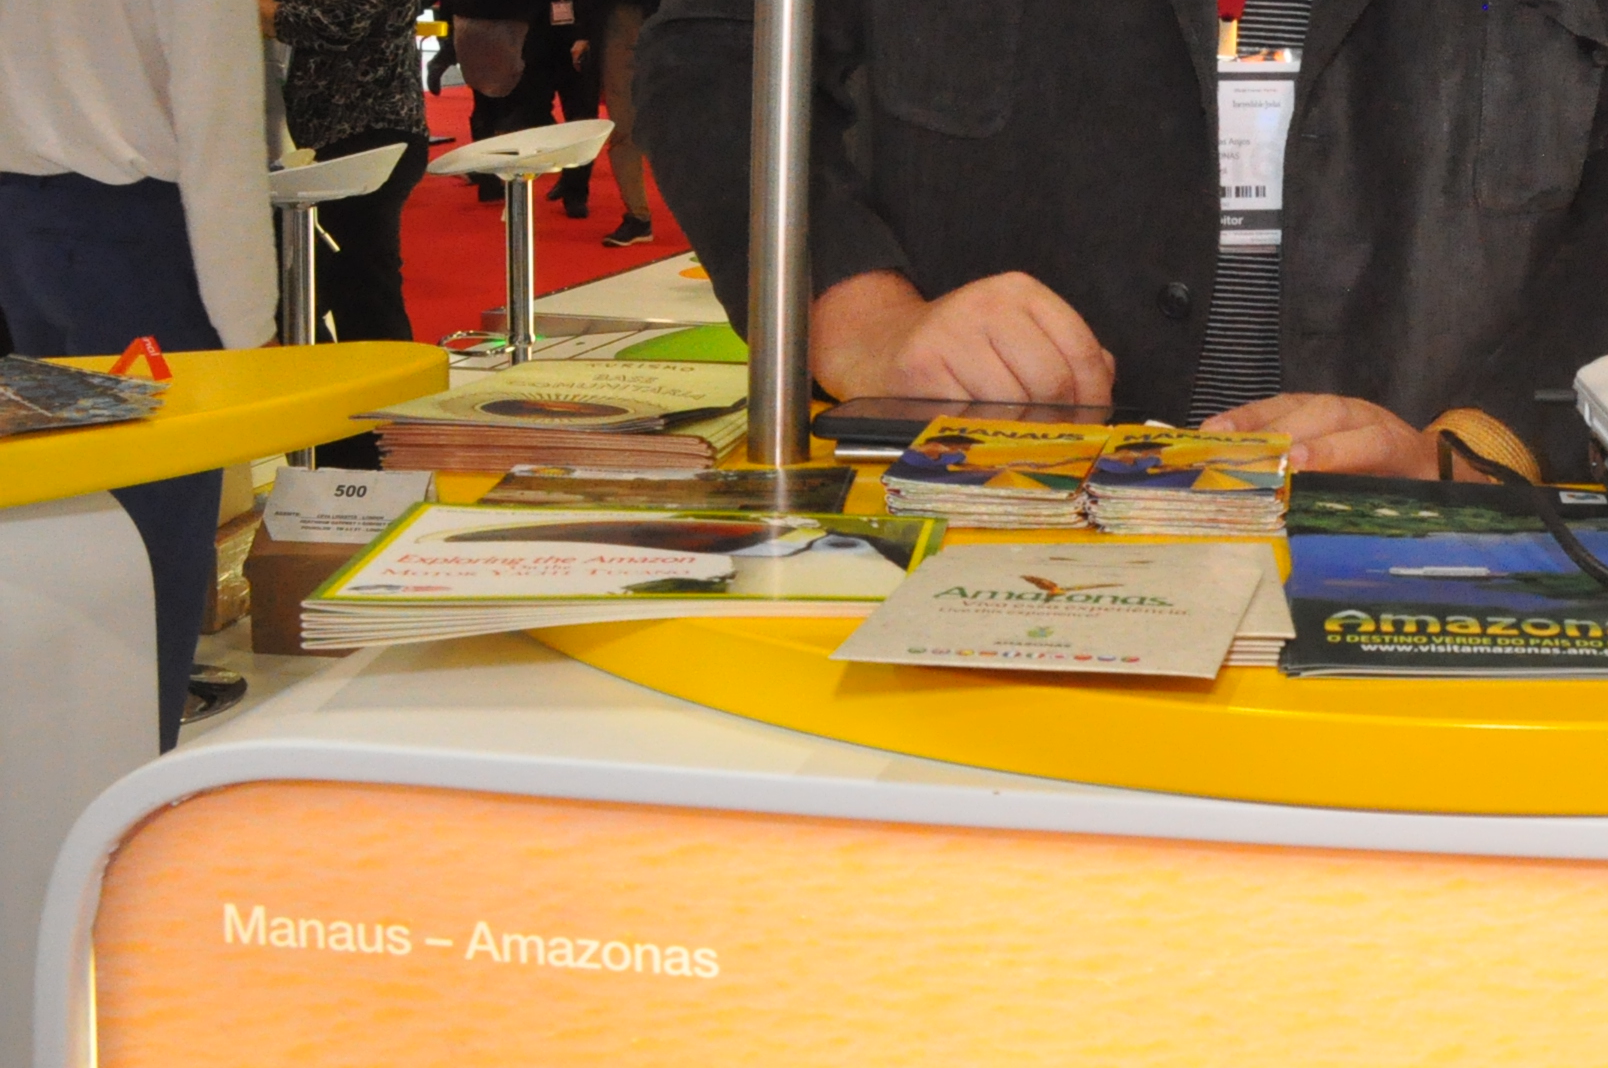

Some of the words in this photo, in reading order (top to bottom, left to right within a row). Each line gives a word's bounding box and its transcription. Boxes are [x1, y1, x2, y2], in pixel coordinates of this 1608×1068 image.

[1220, 215, 1244, 225] itor
[939, 426, 1086, 441] MANAUS
[1123, 433, 1268, 444] MANAUS
[334, 484, 367, 498] 500
[398, 553, 524, 565] Exploring
[532, 554, 577, 564] the
[584, 554, 696, 564] Amazon
[961, 600, 1007, 609] Viva
[1013, 602, 1059, 610] essa
[974, 607, 1002, 615] this
[1327, 634, 1341, 643] O
[1346, 634, 1433, 645] DESTINO
[1435, 635, 1492, 646] VERDE
[1496, 636, 1521, 646] DO
[1574, 638, 1603, 648] DO
[223, 902, 412, 955] Manaus
[464, 920, 720, 979] Amazonas
